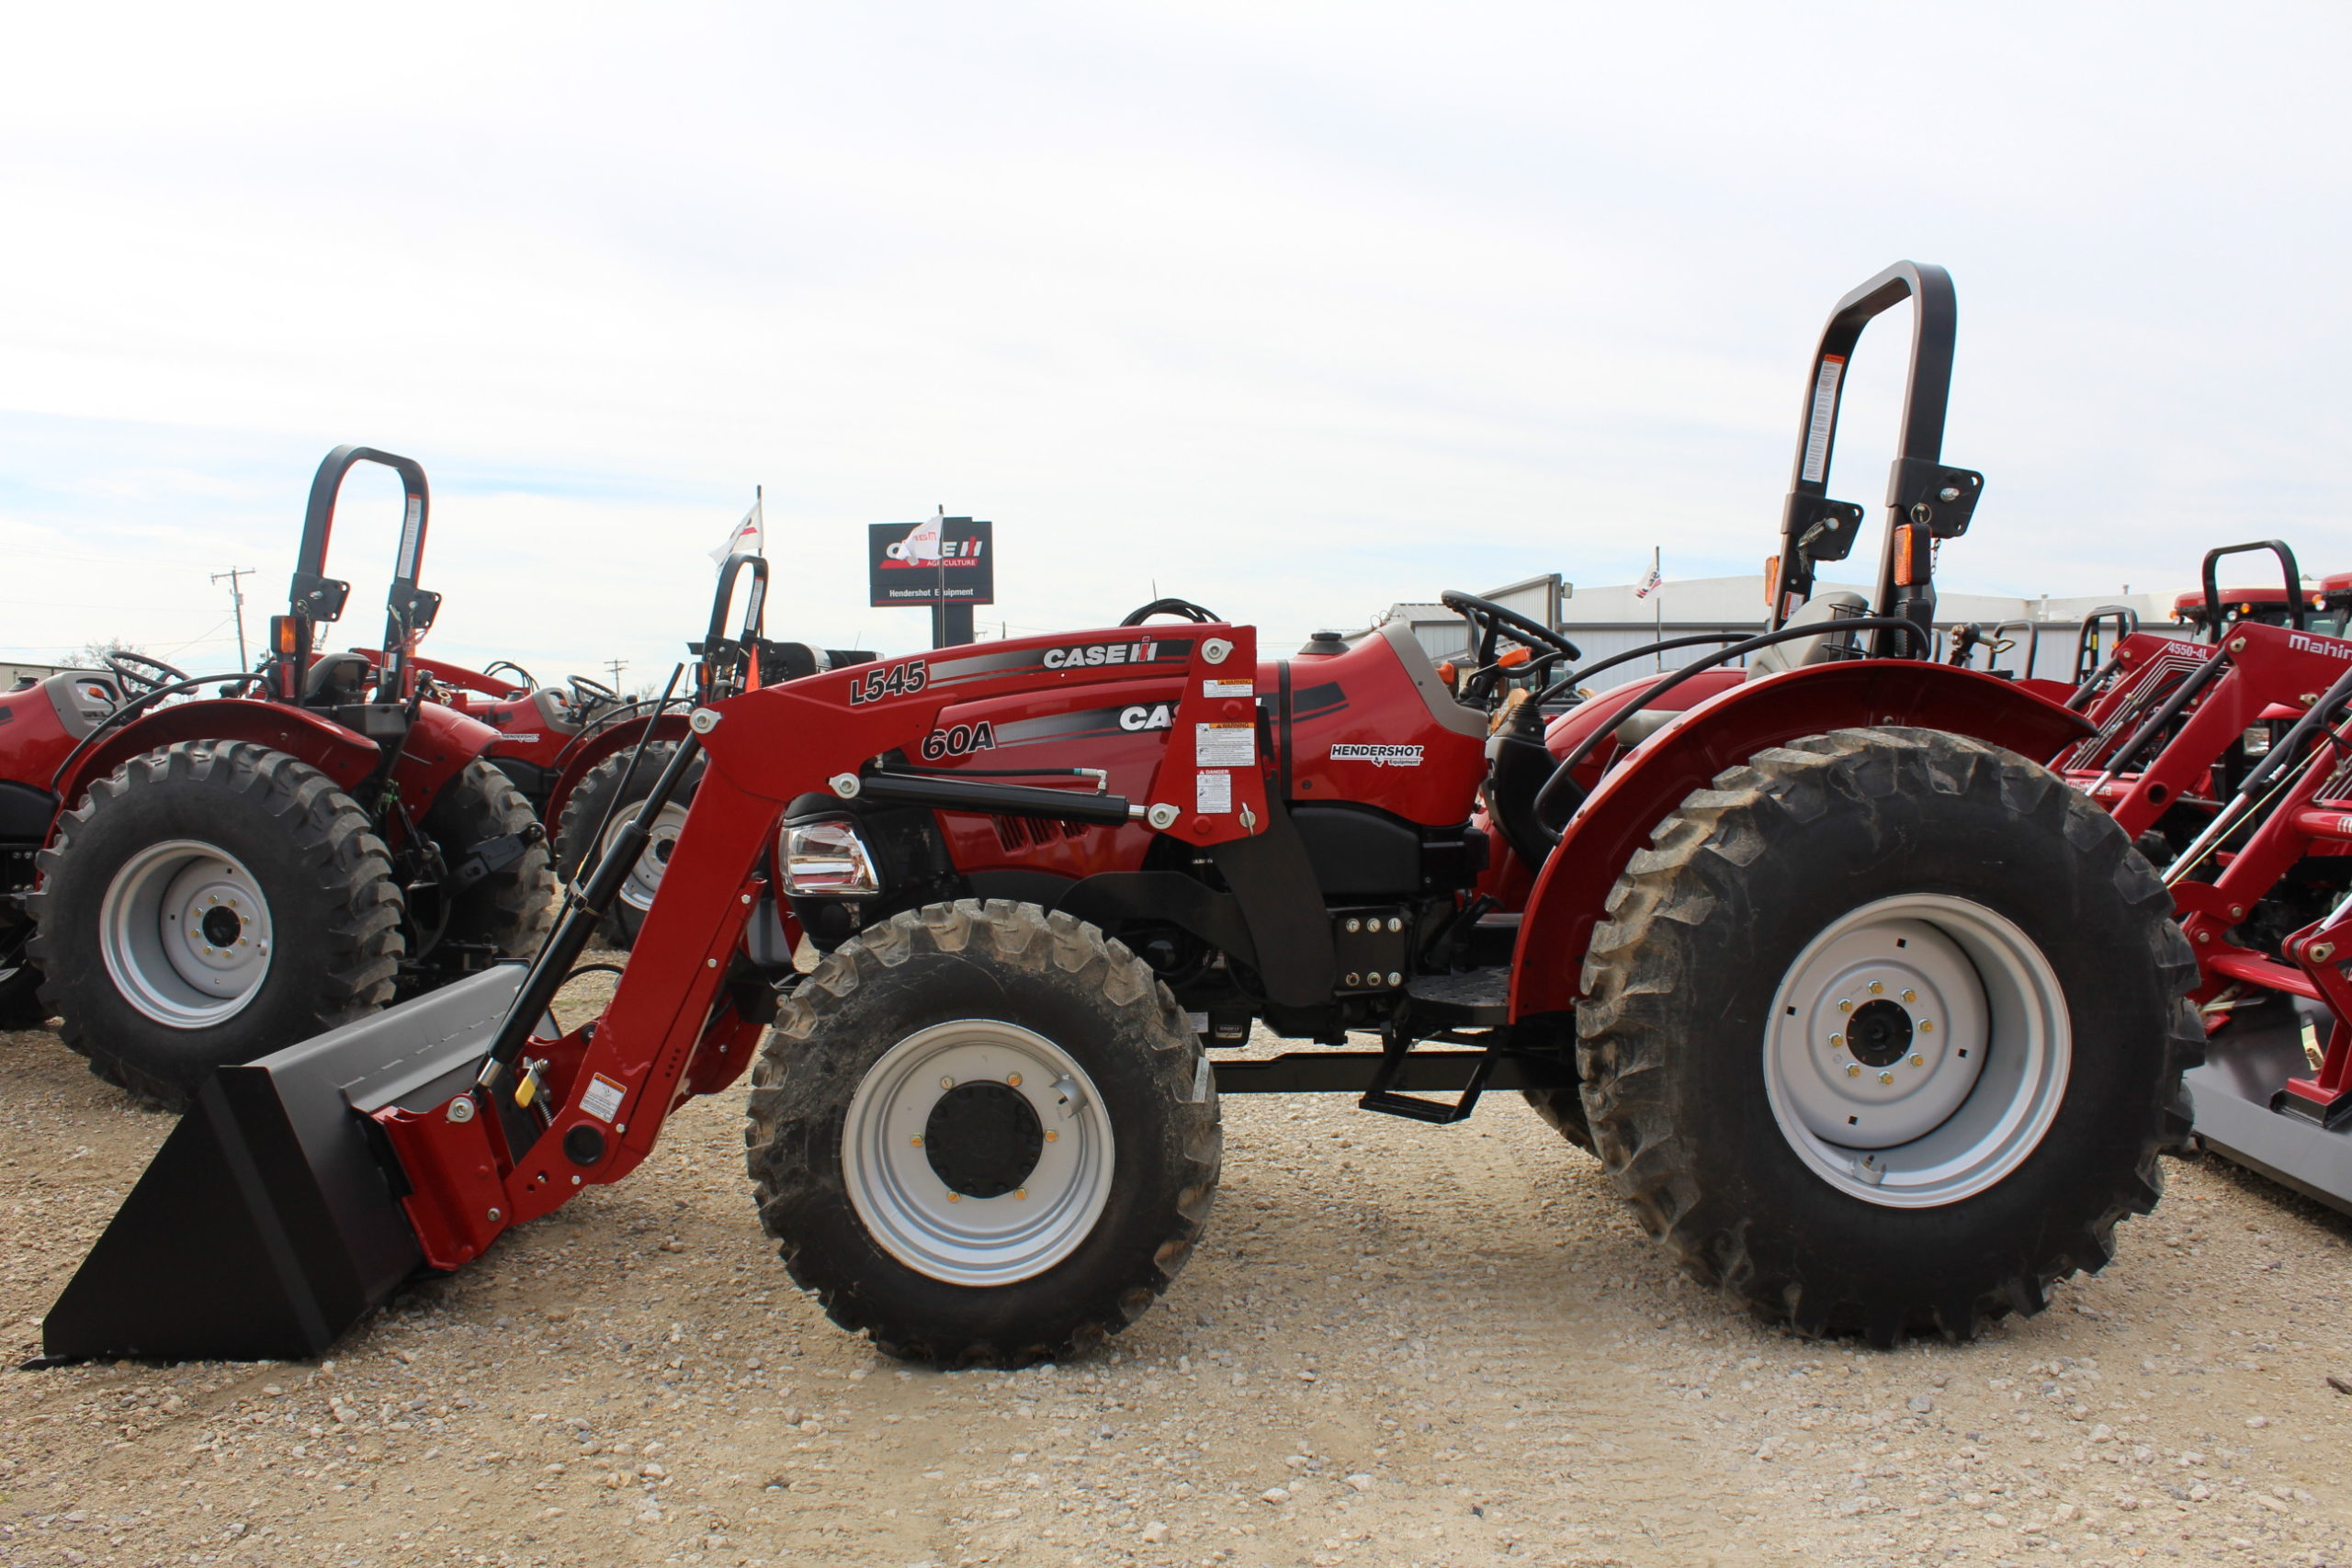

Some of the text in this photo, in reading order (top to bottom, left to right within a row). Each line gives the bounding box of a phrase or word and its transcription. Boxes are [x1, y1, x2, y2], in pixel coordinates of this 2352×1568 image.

[889, 588, 974, 598] Hendershot Euipment
[2168, 643, 2208, 660] 4550-4L
[850, 660, 926, 705] L545
[922, 720, 996, 761] 60A
[1332, 746, 1423, 757] HENDERSHOT
